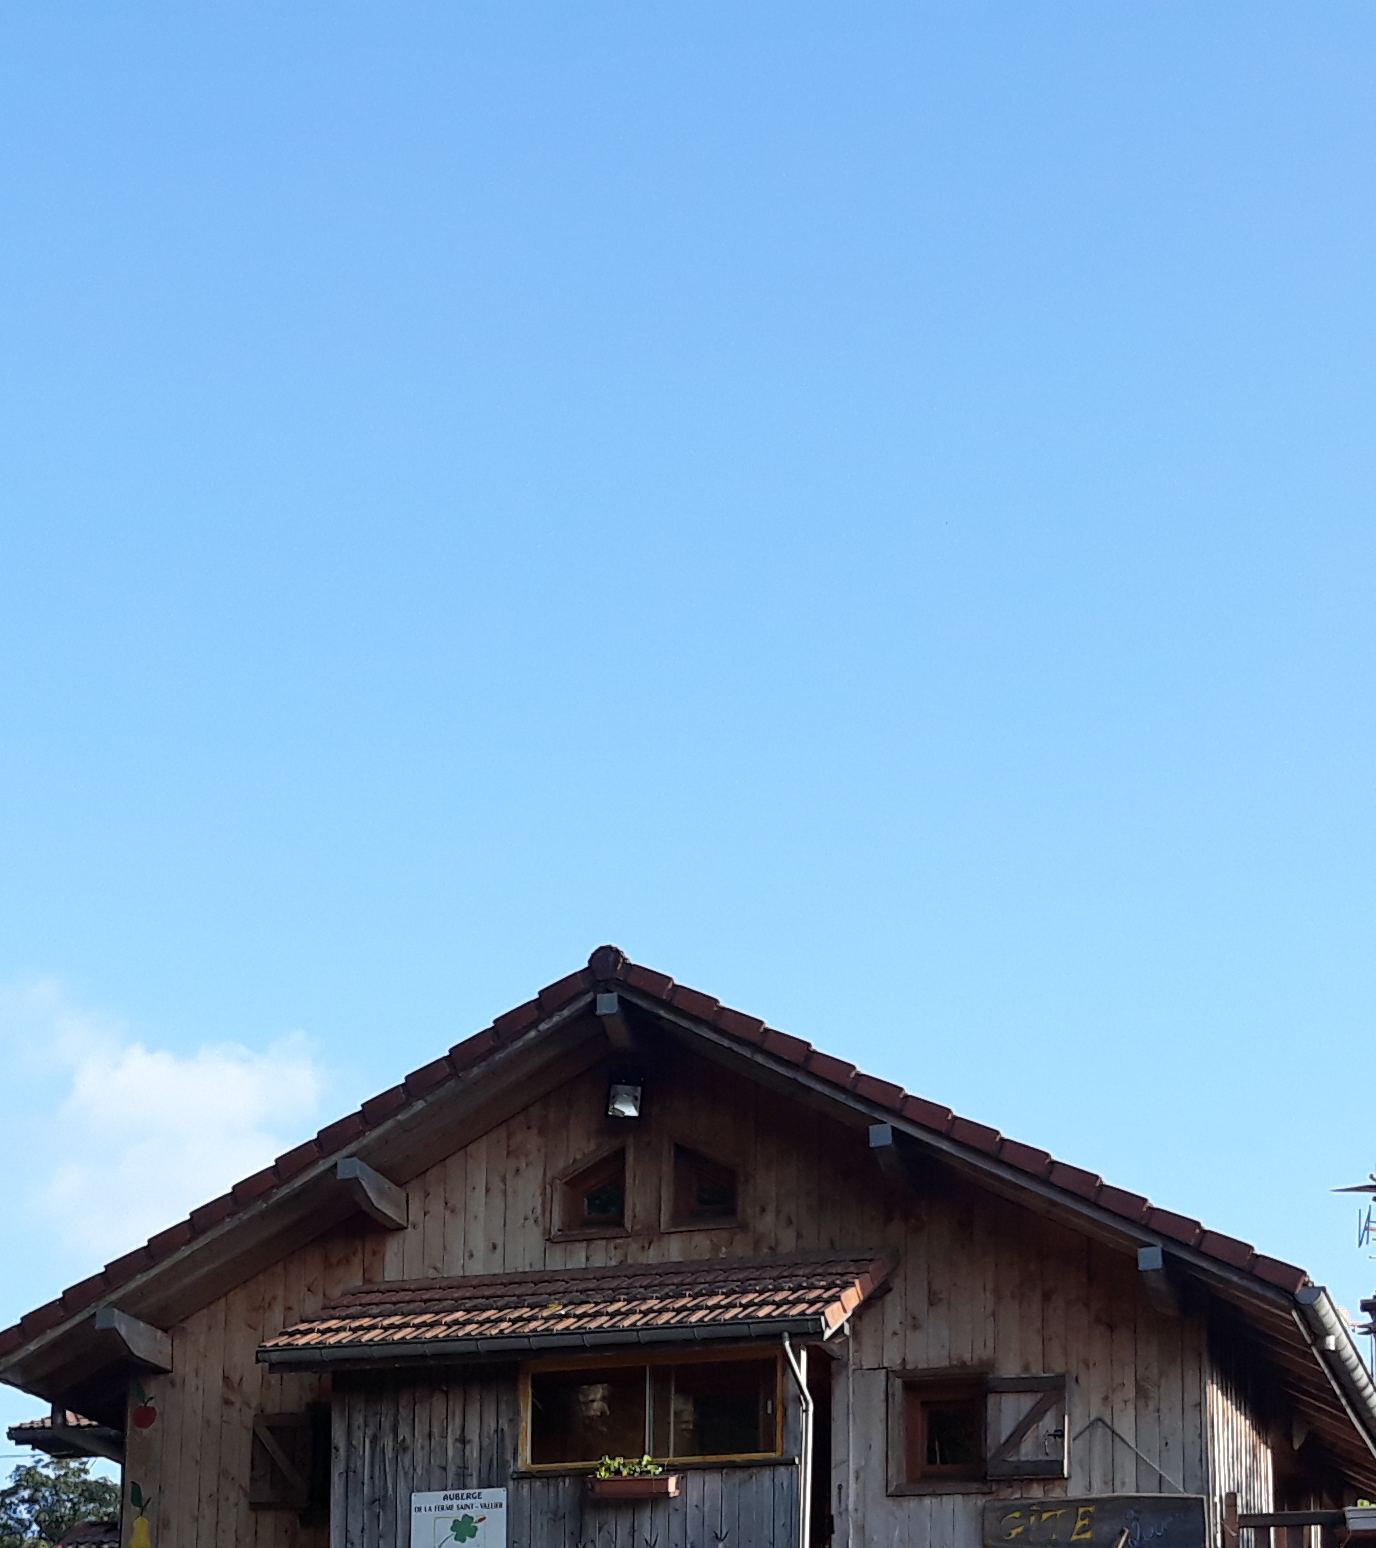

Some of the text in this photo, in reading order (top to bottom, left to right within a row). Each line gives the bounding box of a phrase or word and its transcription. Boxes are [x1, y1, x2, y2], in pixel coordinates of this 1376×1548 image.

[442, 1491, 483, 1502] AUBERGE
[424, 1505, 432, 1513] LA
[434, 1504, 454, 1512] FERME
[456, 1503, 474, 1511] SAINT
[479, 1502, 503, 1510] VALLIER
